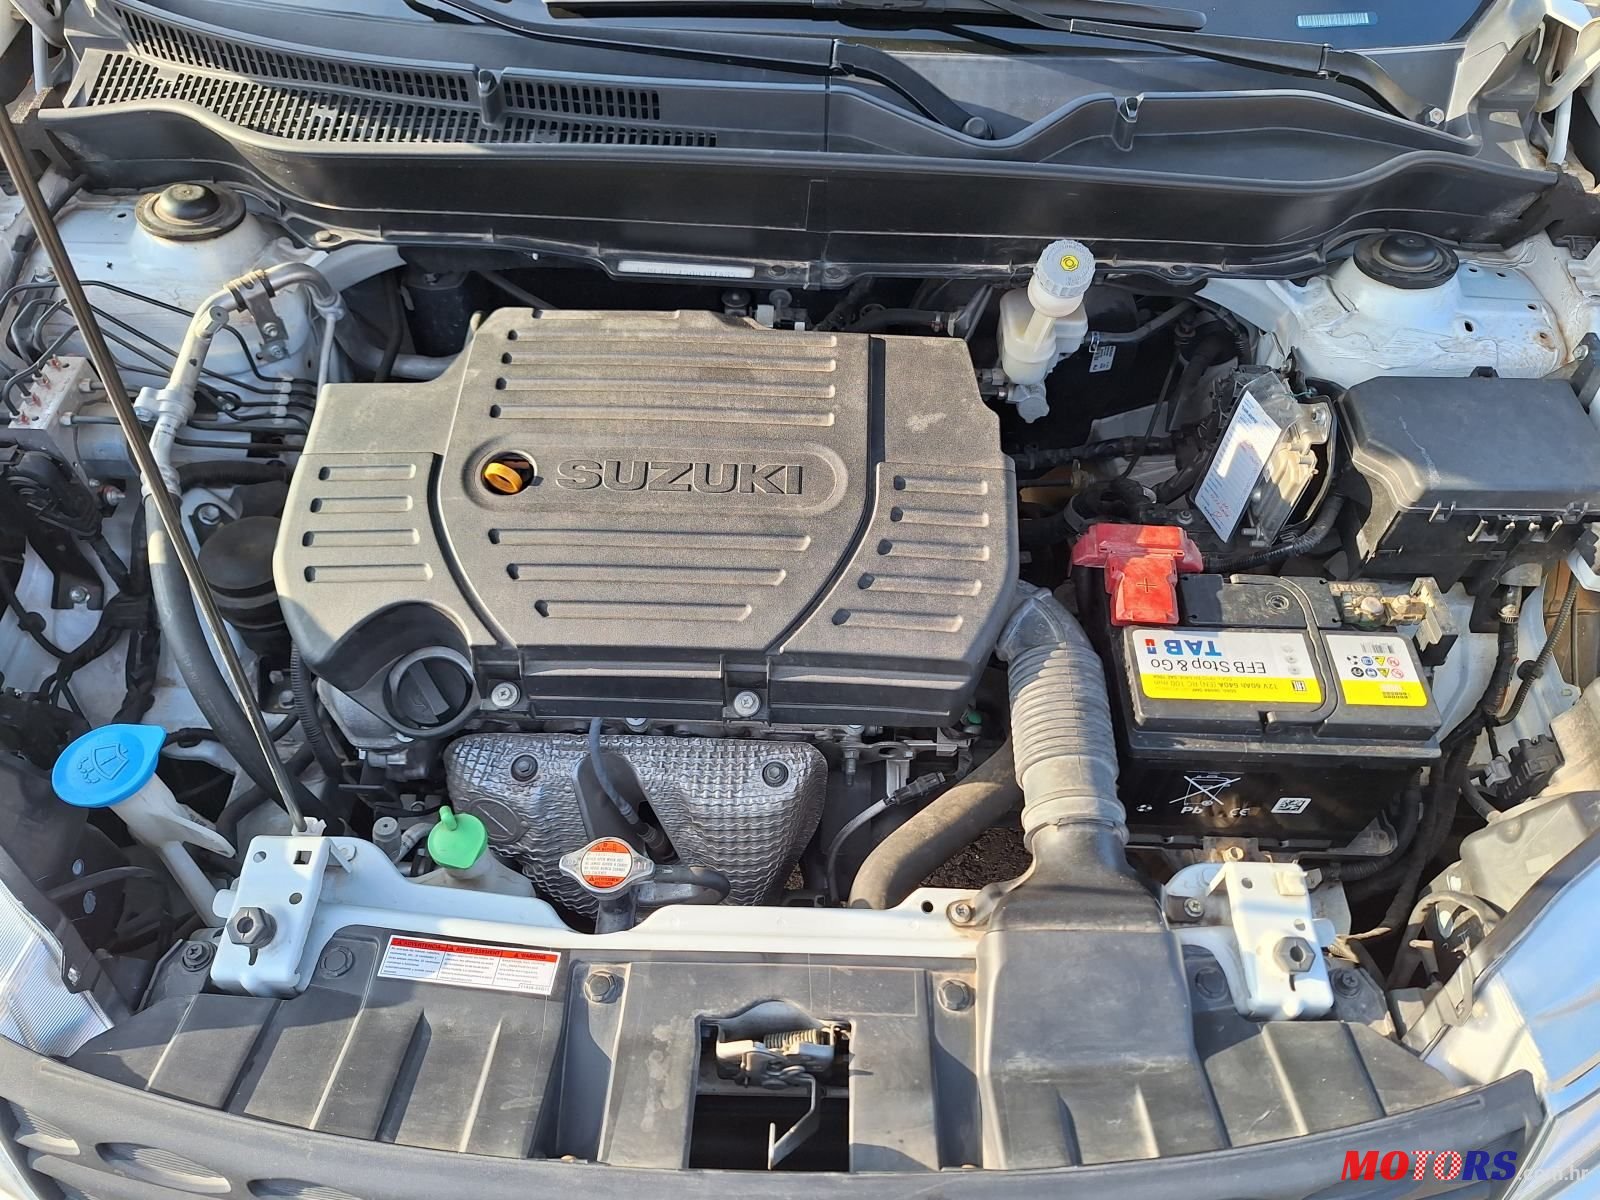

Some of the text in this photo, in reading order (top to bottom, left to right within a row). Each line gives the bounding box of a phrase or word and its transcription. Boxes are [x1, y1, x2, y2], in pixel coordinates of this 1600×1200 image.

[555, 459, 803, 495] SUZUKI
[1164, 639, 1222, 657] TAB
[1151, 657, 1266, 674] EFB Stop & Go
[1180, 806, 1204, 814] Pb
